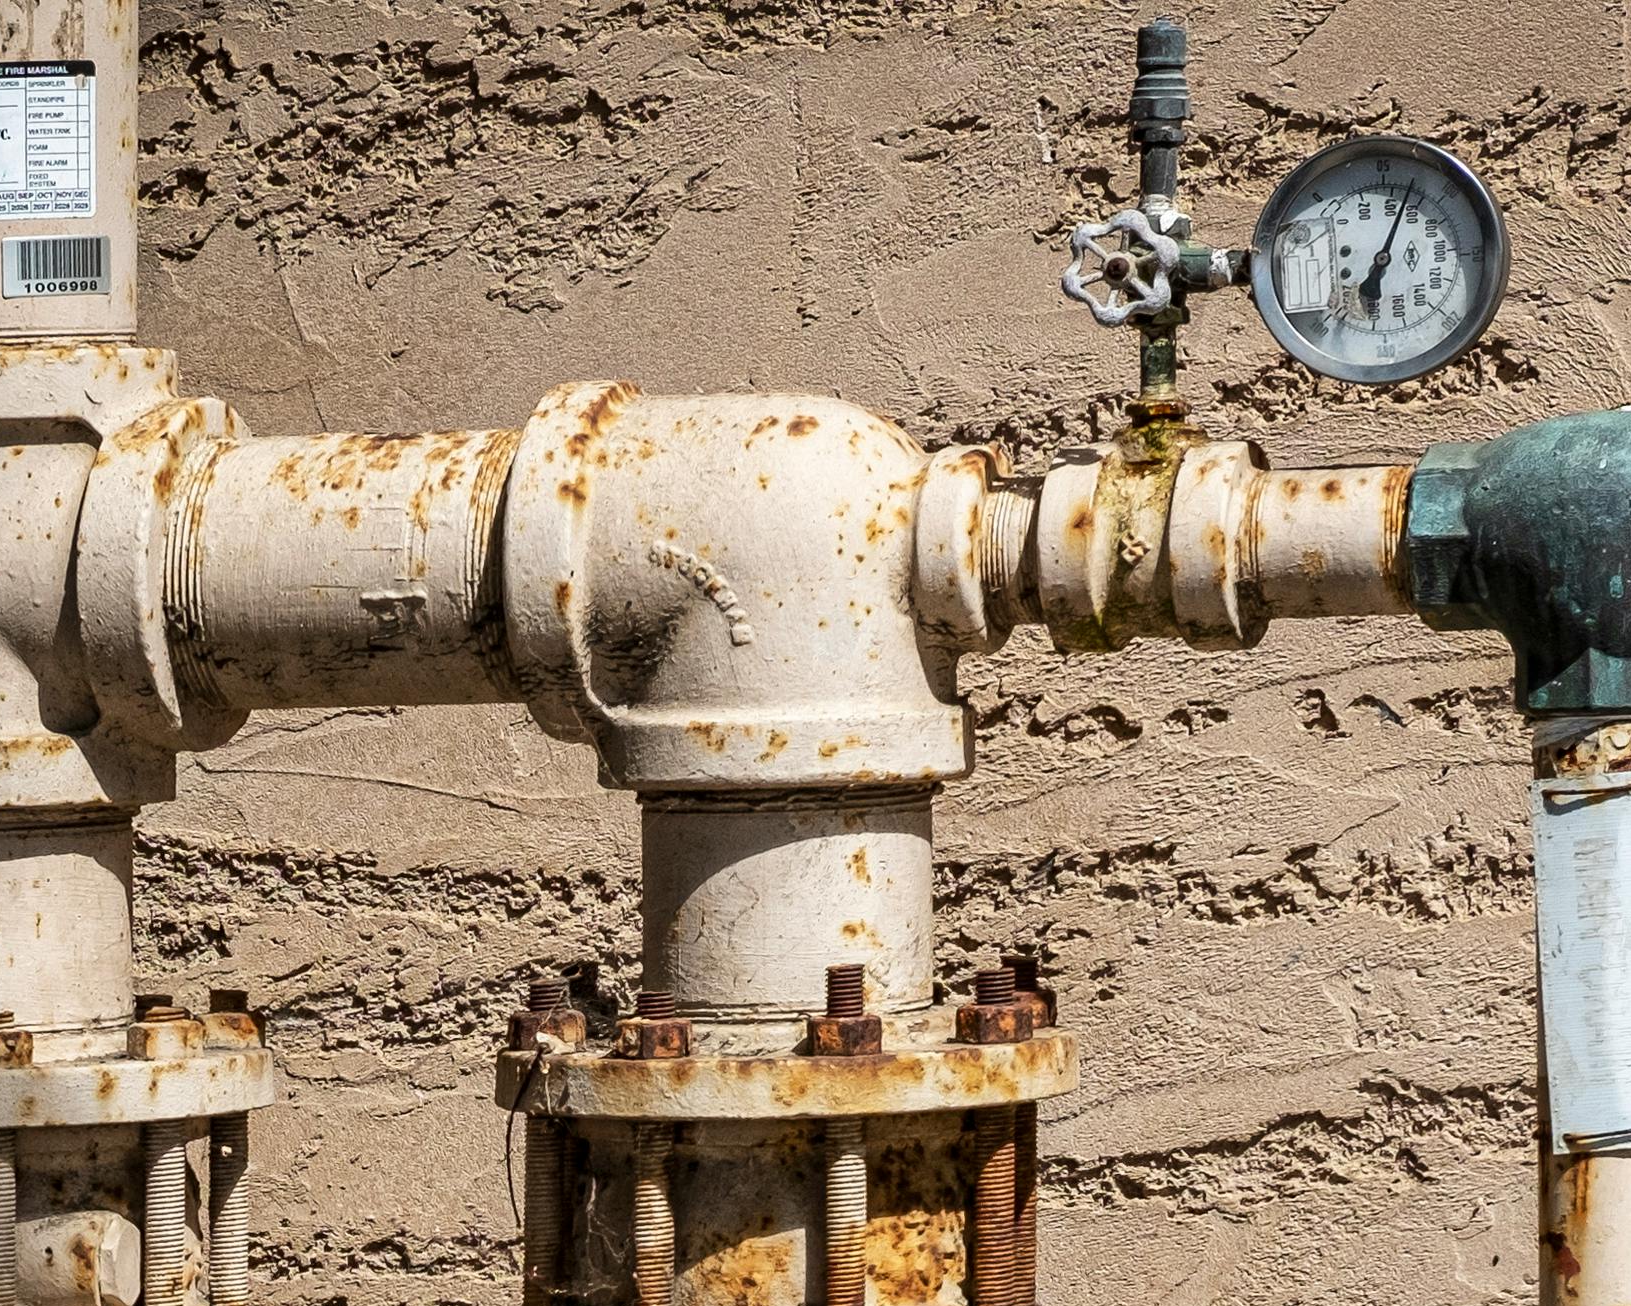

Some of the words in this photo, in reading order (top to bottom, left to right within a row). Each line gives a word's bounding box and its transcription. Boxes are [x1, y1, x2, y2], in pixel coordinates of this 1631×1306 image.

[5, 66, 25, 75] FIRE
[27, 65, 69, 74] MARSHAL
[45, 111, 64, 119] PUMP
[1376, 159, 1390, 172] 50
[17, 191, 34, 199] SEP
[37, 191, 53, 199] OCT
[56, 190, 72, 198] NOV
[74, 190, 88, 198] DEC
[1312, 191, 1323, 202] 0
[1358, 201, 1371, 221] 200
[1384, 199, 1397, 217] 400
[1405, 204, 1419, 224] 600
[1336, 218, 1349, 226] 0
[1424, 218, 1438, 238] 800
[1433, 239, 1447, 263] 1000
[24, 280, 98, 294] 1006998
[1429, 266, 1442, 290] 1200
[1412, 283, 1426, 307] 1400
[1392, 294, 1405, 318] 1600
[1440, 310, 1462, 332] 200
